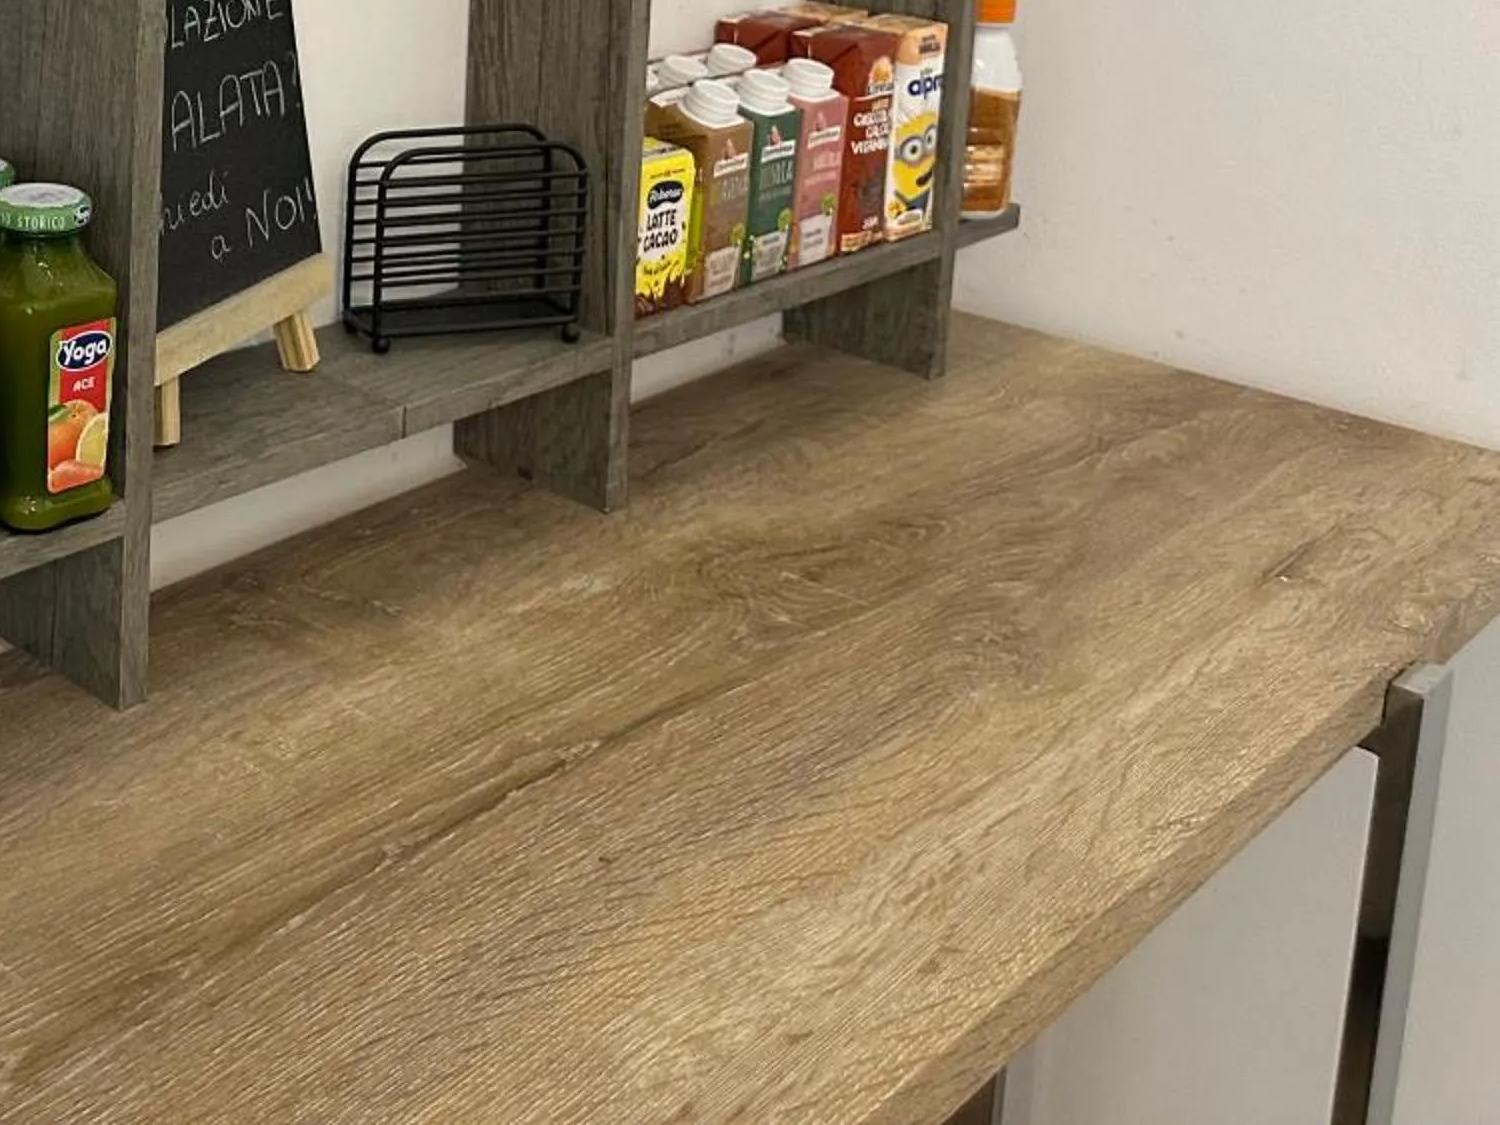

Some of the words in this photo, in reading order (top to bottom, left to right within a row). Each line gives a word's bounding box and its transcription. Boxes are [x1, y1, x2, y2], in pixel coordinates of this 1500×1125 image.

[171, 50, 299, 152] ALATA?
[17, 214, 66, 229] STORICO
[647, 209, 677, 231] LATTE
[211, 234, 231, 260] a
[643, 228, 679, 253] CACAO
[63, 339, 107, 365] Yoga
[73, 376, 95, 392] ACE
